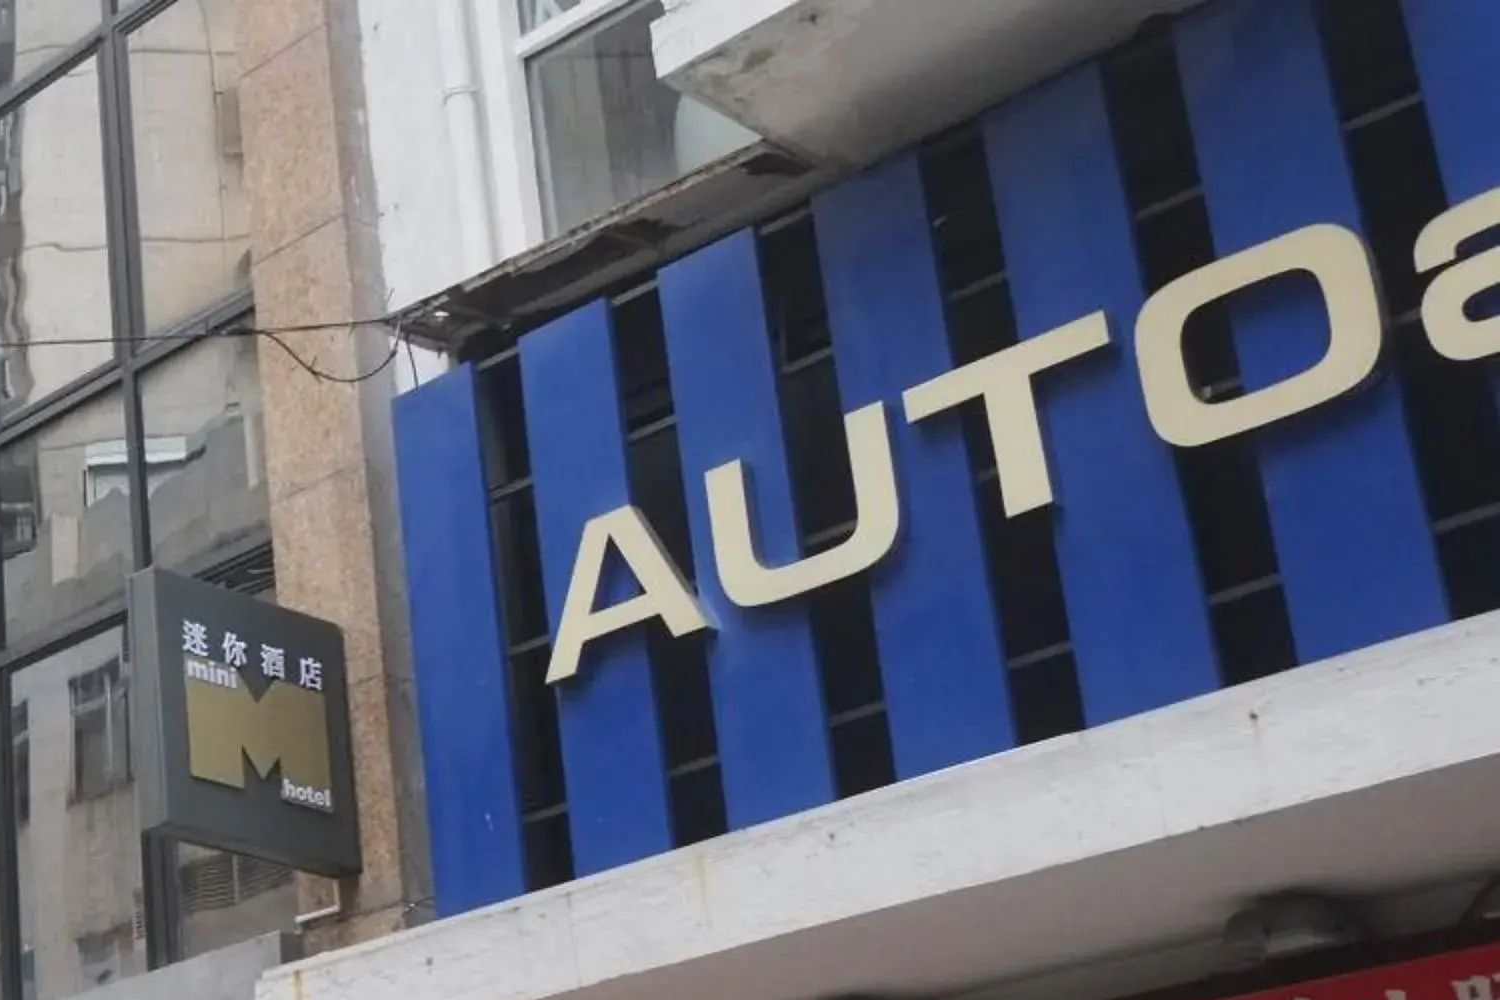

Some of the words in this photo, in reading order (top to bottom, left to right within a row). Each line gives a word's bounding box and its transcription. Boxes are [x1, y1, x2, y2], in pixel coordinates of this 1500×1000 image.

[182, 620, 323, 691] 迷你酒店
[186, 659, 238, 689] mini
[282, 777, 333, 808] hotel
